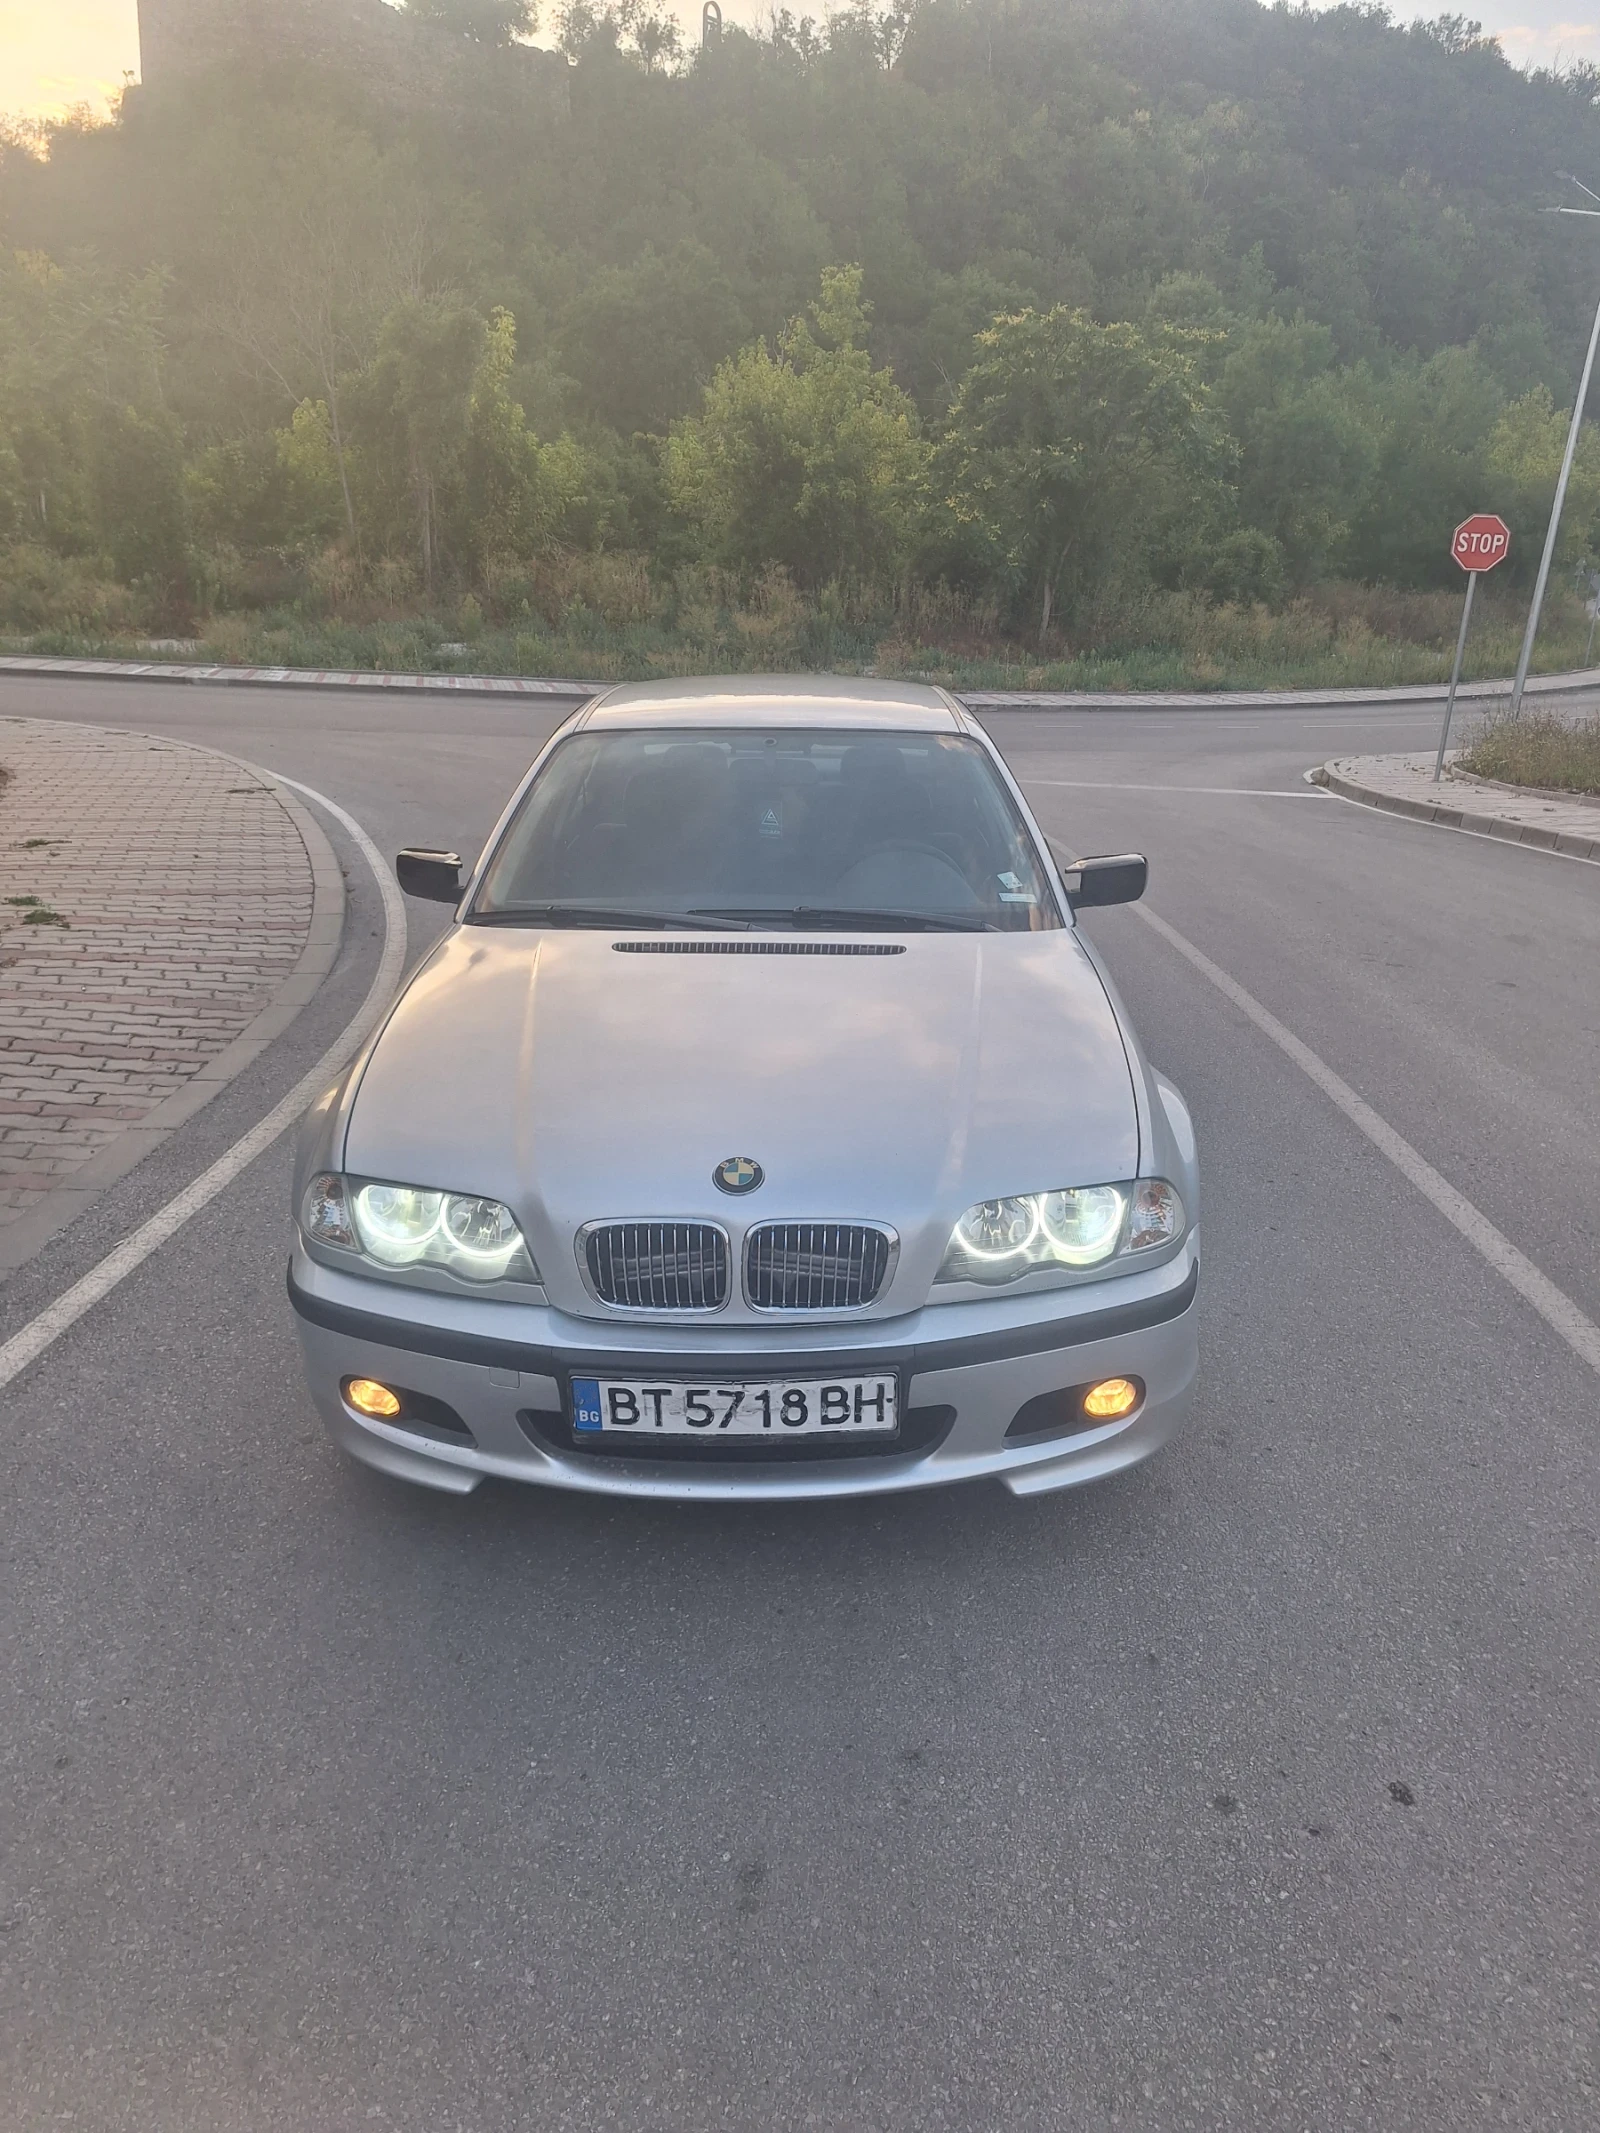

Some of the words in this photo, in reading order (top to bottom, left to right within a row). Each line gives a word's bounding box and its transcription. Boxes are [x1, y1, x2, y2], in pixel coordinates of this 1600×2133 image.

[1457, 532, 1505, 554] STOP
[720, 1158, 759, 1169] BMW
[608, 1387, 672, 1427] BT
[685, 1388, 808, 1428] 5718
[820, 1382, 886, 1425] BH
[579, 1409, 600, 1423] BG
